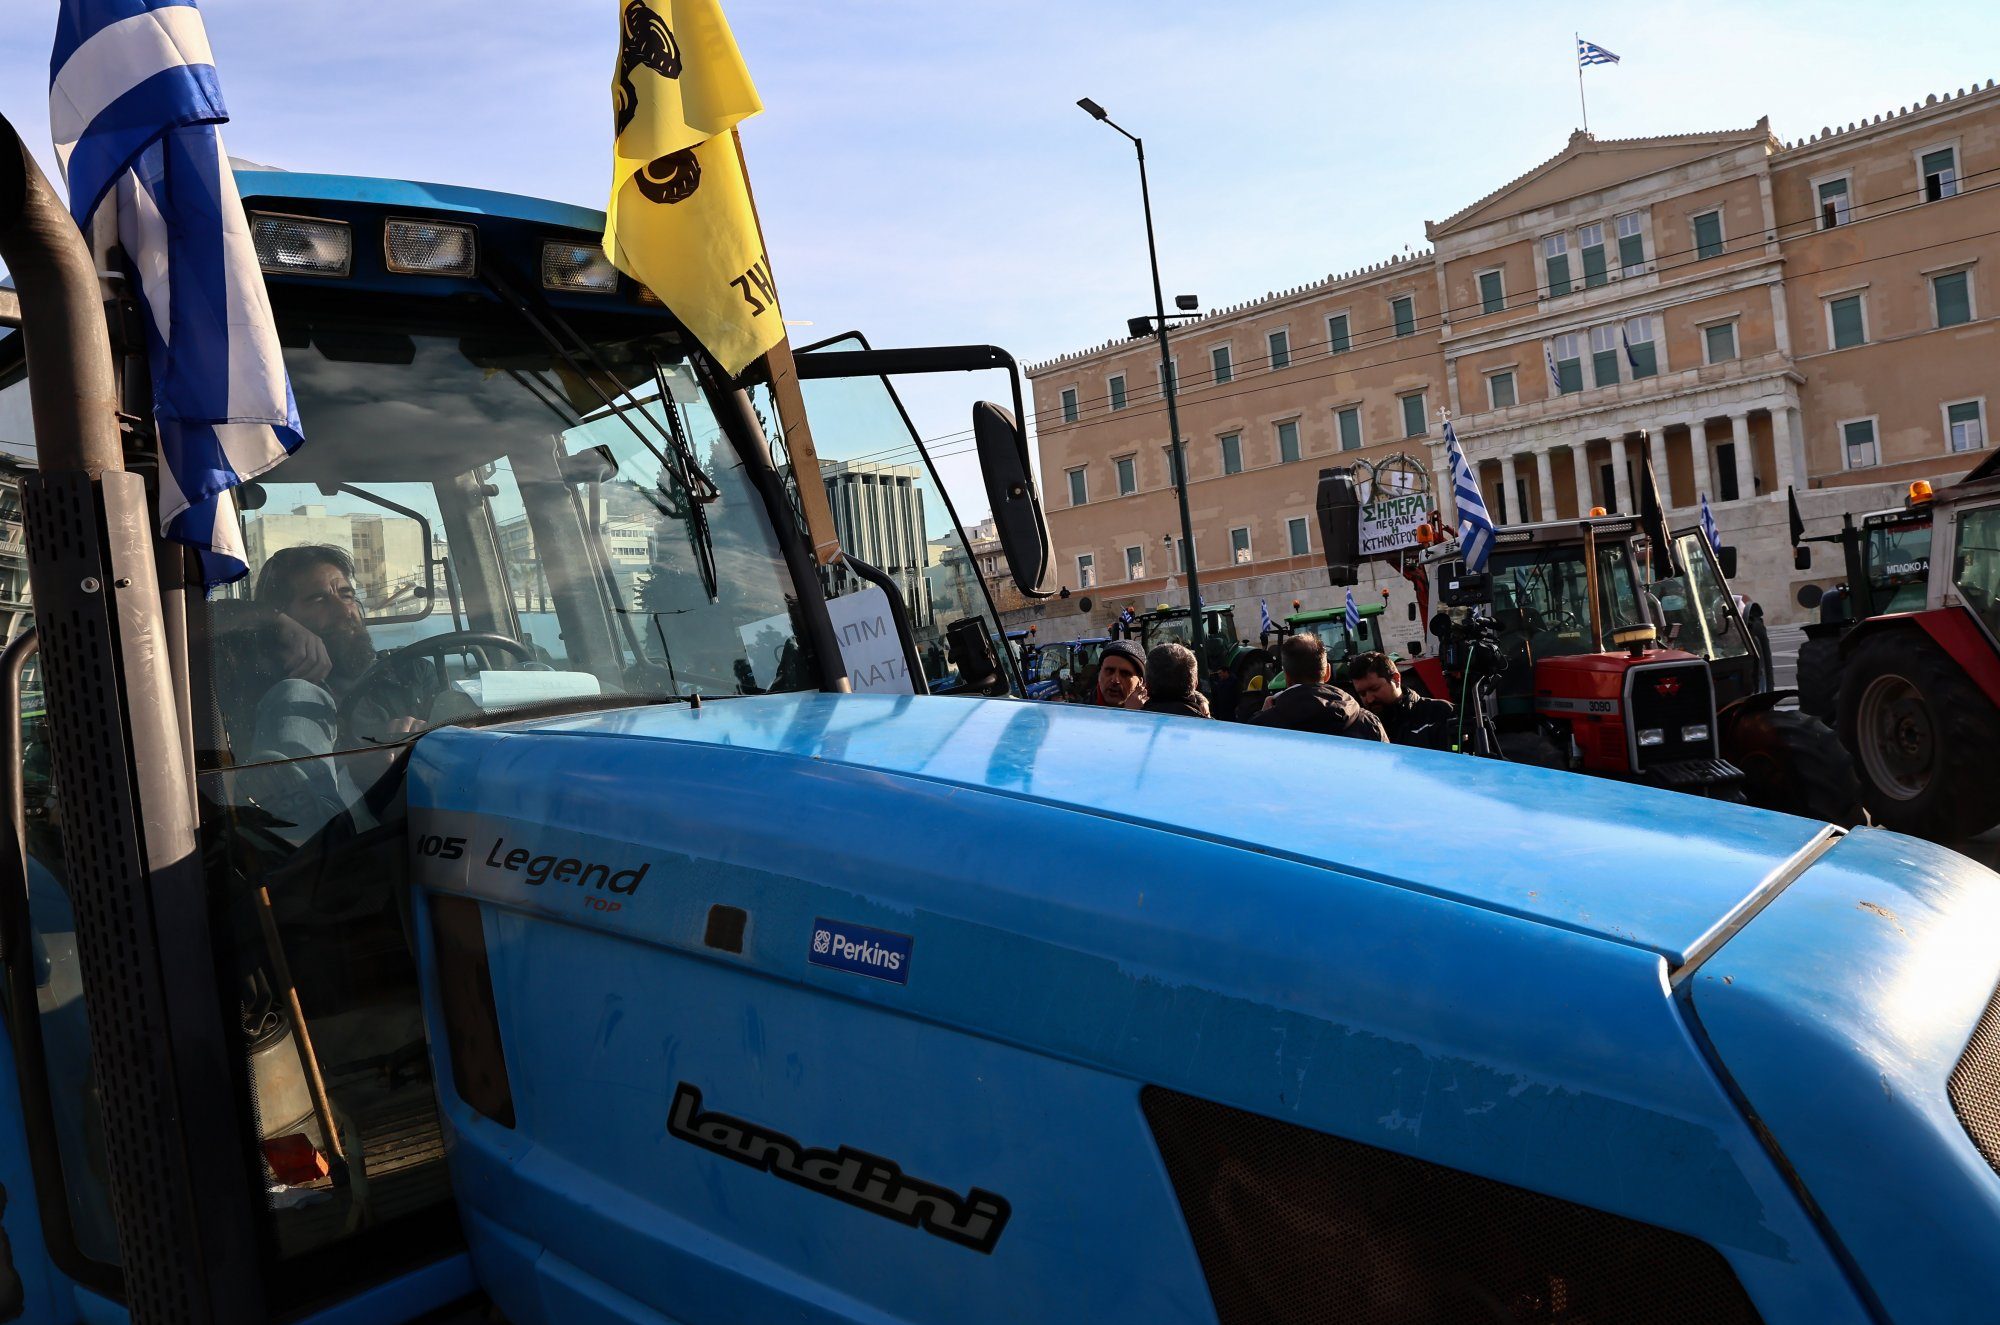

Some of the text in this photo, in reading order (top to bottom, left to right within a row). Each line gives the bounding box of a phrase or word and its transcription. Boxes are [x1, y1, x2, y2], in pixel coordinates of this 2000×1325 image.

[1362, 495, 1426, 522] ΣΗΜΕΡΑ
[1376, 514, 1417, 529] ΠΕΘΑΝΕ
[1886, 562, 1921, 574] ΜΠΛΟΚΟ
[417, 834, 651, 896] 105 Legend
[584, 896, 622, 912] TOP
[832, 933, 901, 970] Perkins
